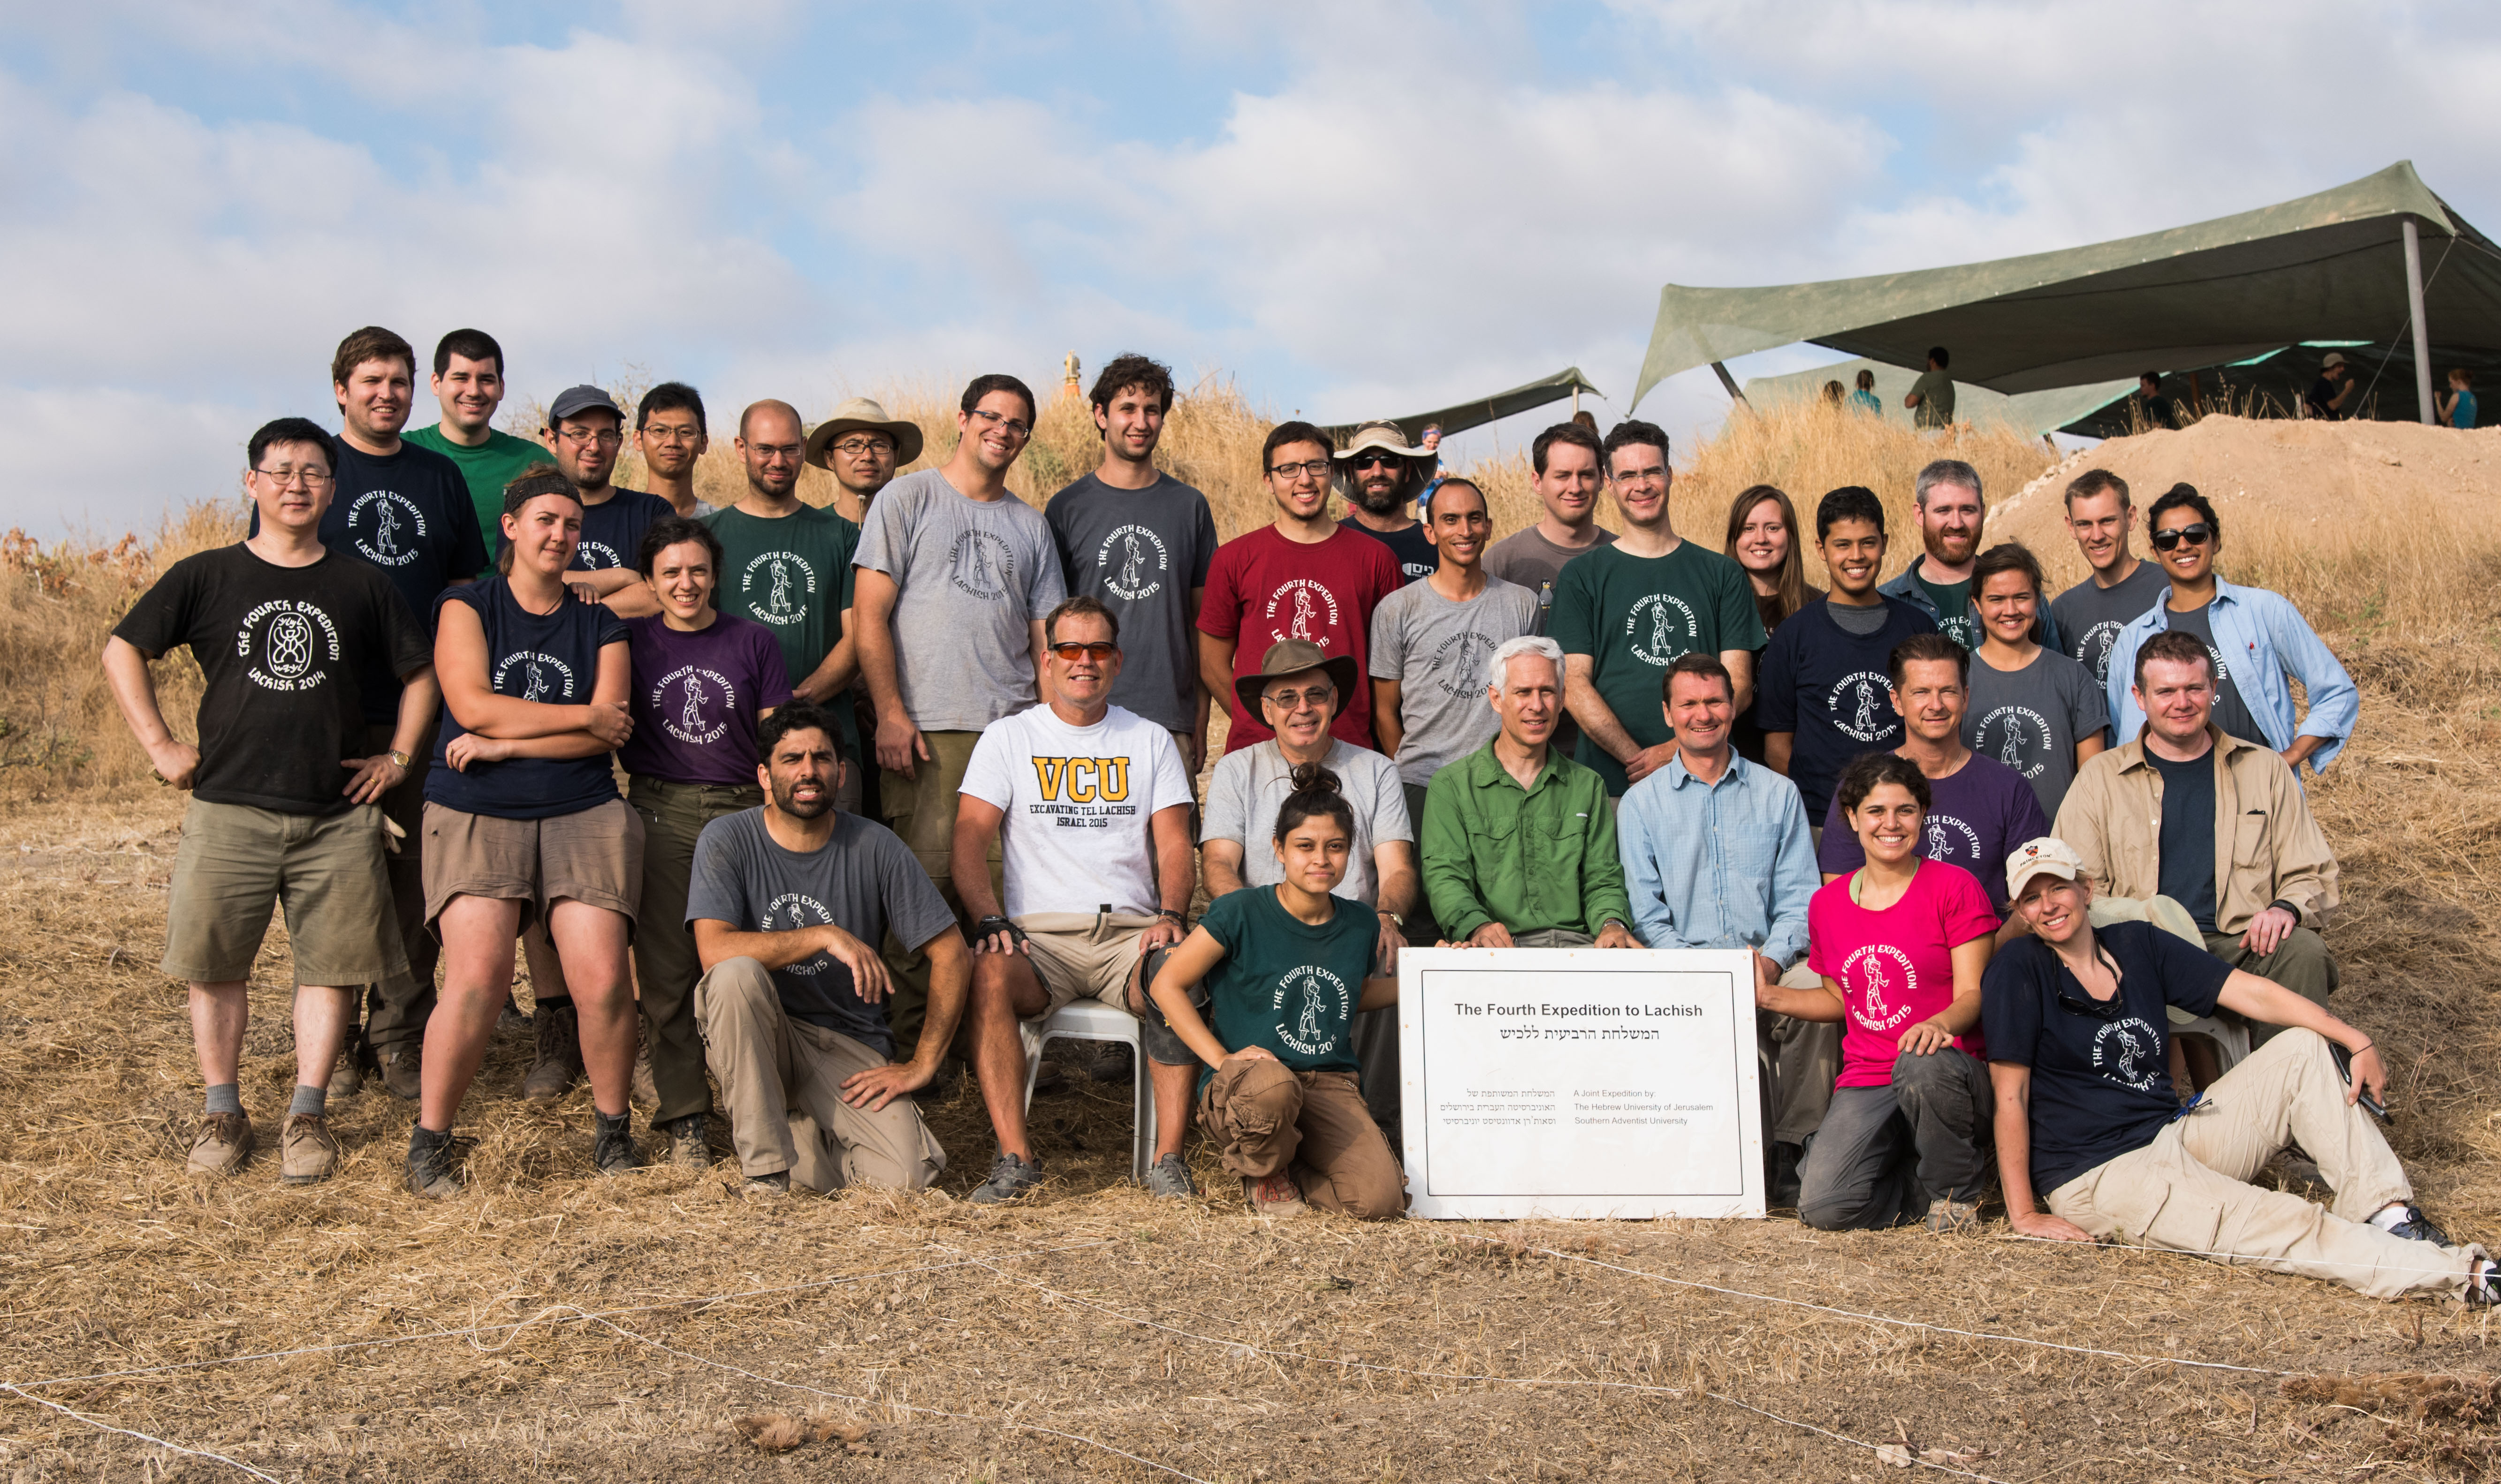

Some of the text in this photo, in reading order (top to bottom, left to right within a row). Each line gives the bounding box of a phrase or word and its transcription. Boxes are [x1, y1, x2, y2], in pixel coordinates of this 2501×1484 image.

[349, 490, 426, 536] THE FOURTH EXPEDITION
[355, 538, 418, 566] LACHISH 2015
[592, 542, 621, 568] EXPEDIT
[950, 530, 1014, 576] THE FOURTH EXPEDITION
[1099, 524, 1167, 570] THE FOURTH EXPEDITION
[743, 551, 815, 593] THE FOURTH EXPEDITION
[952, 575, 1008, 600] LACHISH 2015
[1137, 582, 1160, 599] 2015
[749, 601, 808, 625] LACHISH 2015
[1267, 579, 1338, 625] THE FOURTH EXPEDITION
[1630, 594, 1660, 616] FOURTH
[1663, 594, 1697, 636] EXPEDITION
[2081, 621, 2108, 645] FOURTH
[1432, 631, 1498, 671] THE FOURTH EXPEDI
[1631, 644, 1668, 666] LACHISH
[2206, 645, 2227, 679] EDITION
[298, 671, 326, 690] 2014
[494, 651, 573, 697] THE FOURTH EXPEDITION
[657, 665, 693, 688] FOURTH
[653, 688, 662, 709] THE
[1828, 696, 1838, 712] THE
[1833, 672, 1866, 695] FOURTH
[662, 719, 727, 744] LACHISH 2015
[1834, 720, 1896, 742] LACHISH 2015
[1976, 706, 2052, 750] THE FOURTH EXPEDITION
[1032, 756, 1130, 803] VCU
[1030, 805, 1135, 815] EXCAVATING TEL LACHISH
[1057, 817, 1107, 827] ISRAEL 2015
[1942, 815, 1980, 859] EXPEDITION
[2020, 854, 2051, 867] PRINCETON
[768, 893, 798, 914] FOURTH
[801, 895, 834, 925] EXPEDI
[1841, 945, 1917, 994] THE FOURTH EXPEDITION
[1274, 965, 1349, 1020] THE FOURTH EXPEDITION
[1454, 1004, 1702, 1018] The Fourth Expedition to Lachish
[1852, 1004, 1911, 1030] LACHISH 2015
[1276, 1023, 1315, 1054] LACHISH
[1500, 1025, 1659, 1040] המשלחת הרביעית ללכיש
[2093, 1045, 2103, 1068] THE
[2121, 1018, 2160, 1055] EXPEDITION
[1603, 1090, 1642, 1098] Expedition
[1645, 1090, 1656, 1098] by:
[1624, 1104, 1661, 1112] University
[1650, 1117, 1688, 1126] University
